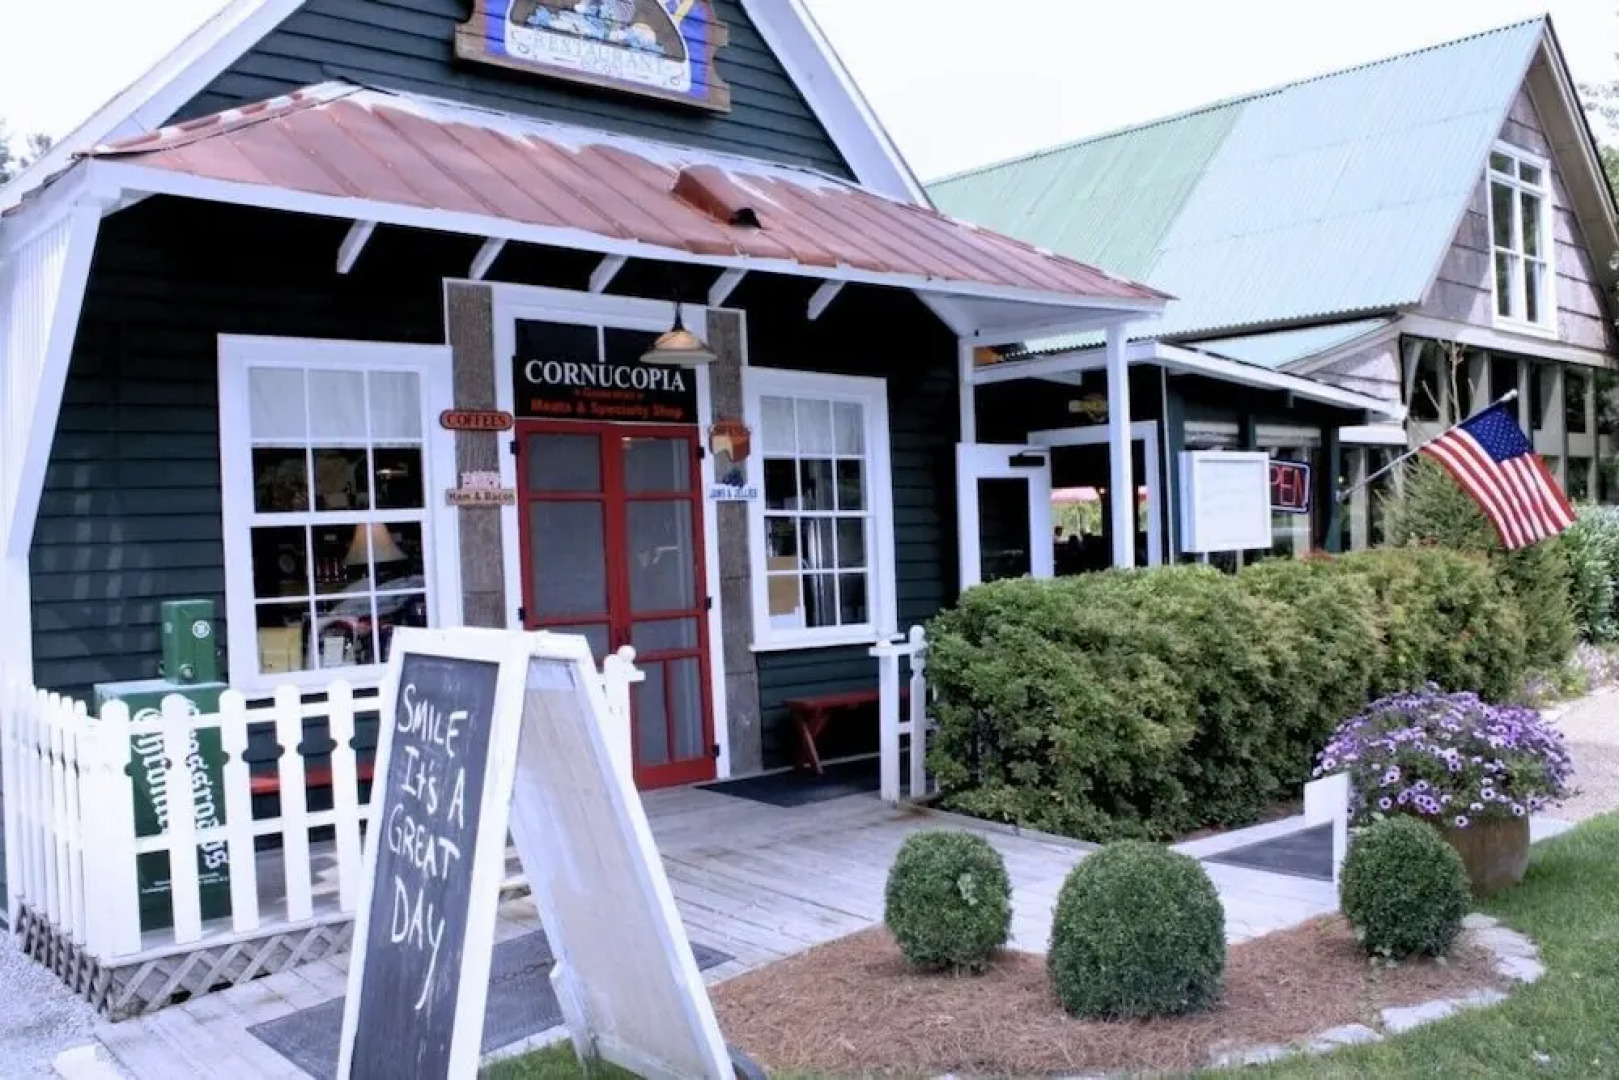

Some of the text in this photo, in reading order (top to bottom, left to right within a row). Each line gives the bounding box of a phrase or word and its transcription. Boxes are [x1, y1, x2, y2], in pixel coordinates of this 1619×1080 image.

[524, 359, 686, 393] CORNUCOPIA
[446, 414, 507, 427] COFFEES
[530, 399, 572, 413] Meats
[575, 401, 587, 414] &
[653, 403, 684, 420] Shop
[1269, 465, 1303, 506] PEN
[397, 683, 468, 759] SMILE
[448, 766, 465, 830] A
[387, 804, 461, 880] GREAT
[390, 875, 446, 1011] DAY
